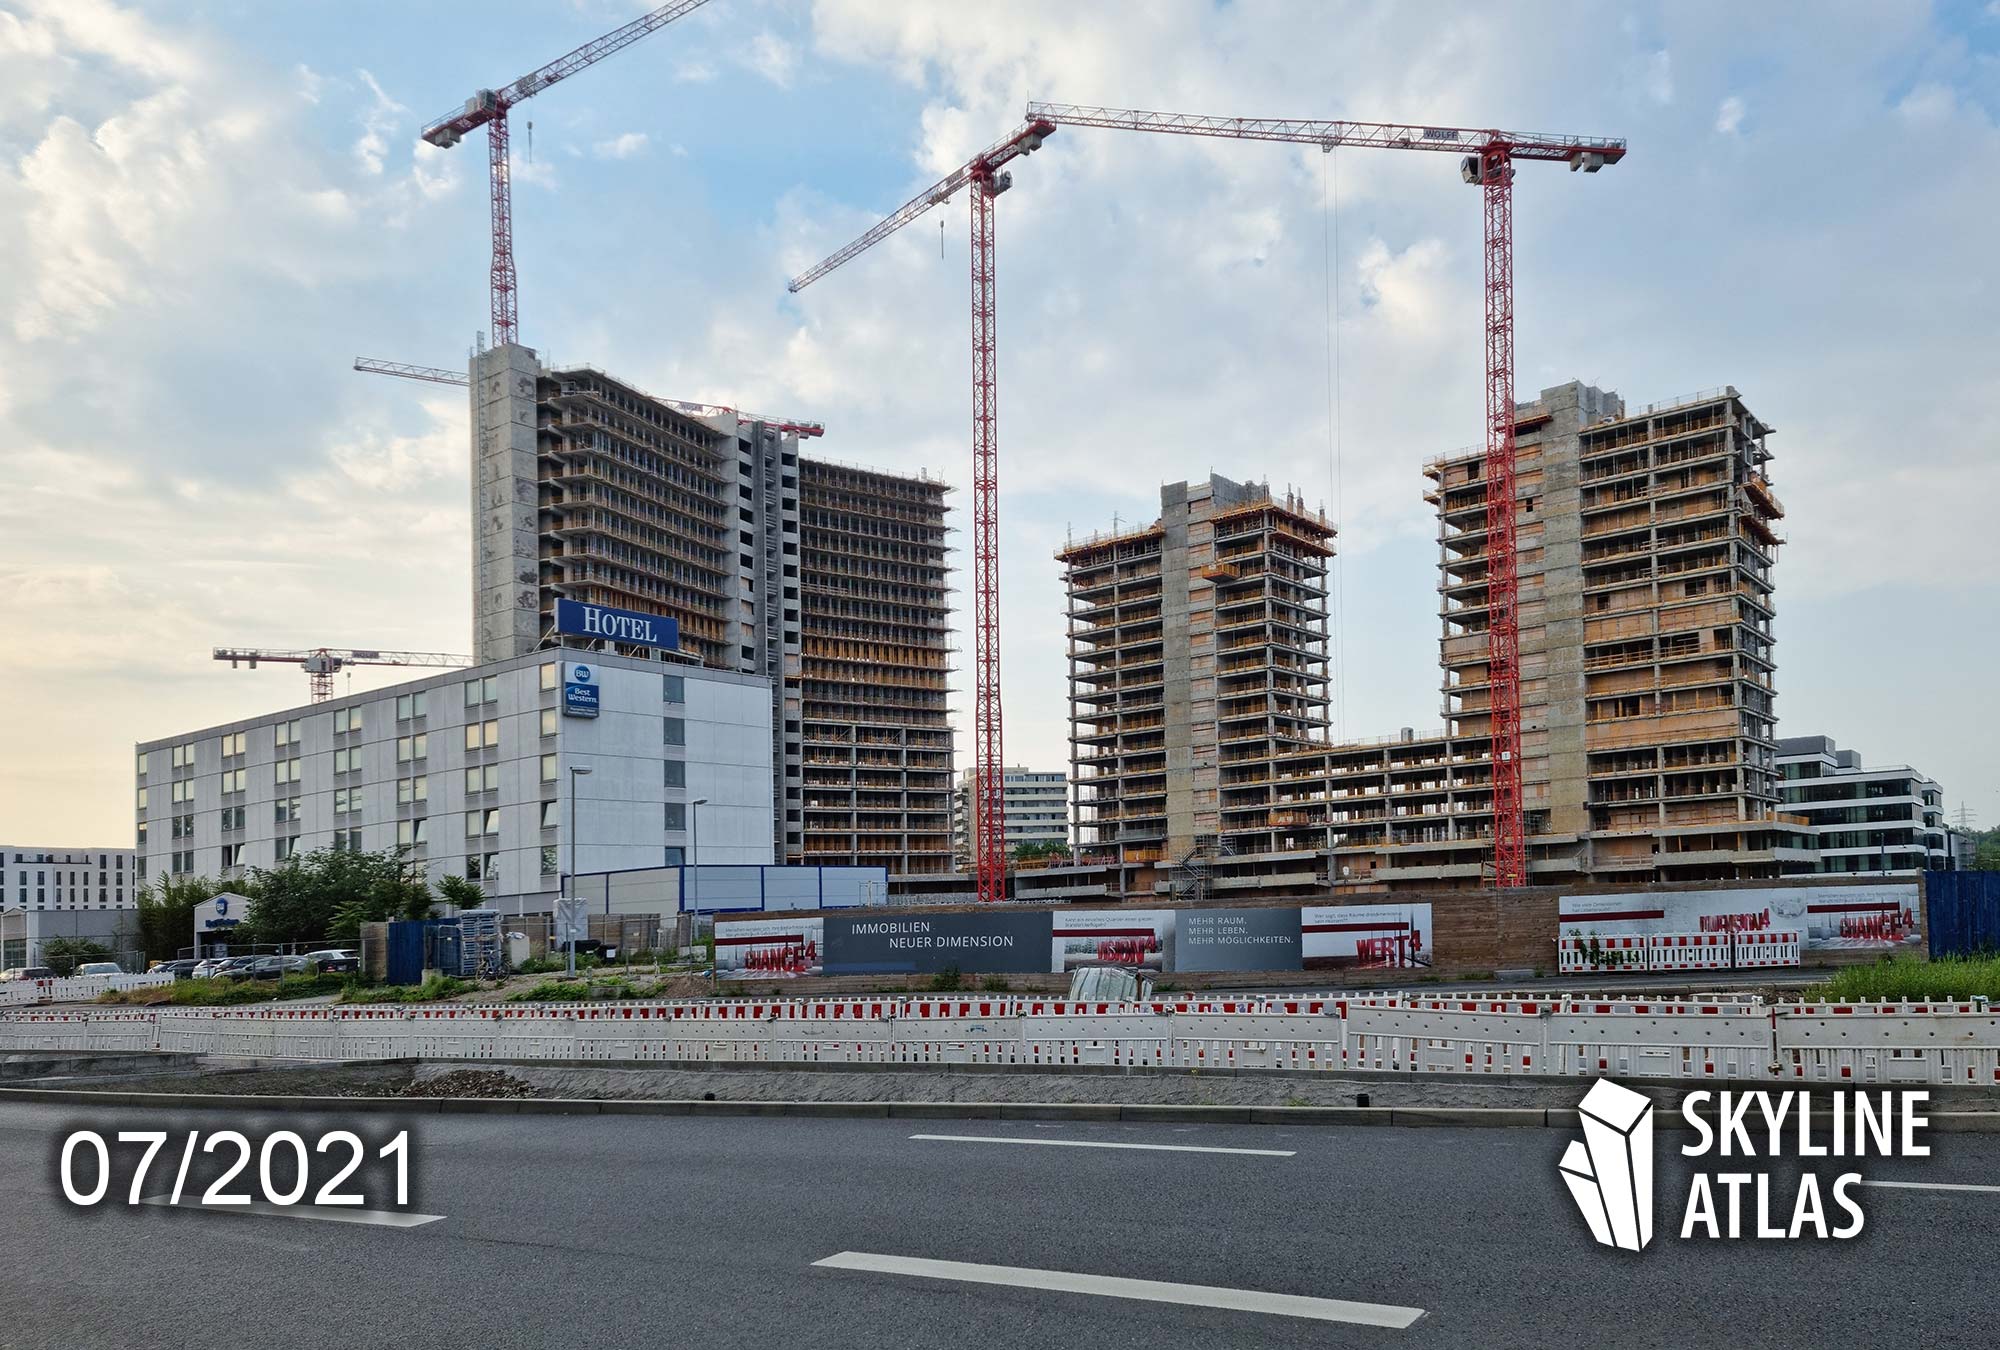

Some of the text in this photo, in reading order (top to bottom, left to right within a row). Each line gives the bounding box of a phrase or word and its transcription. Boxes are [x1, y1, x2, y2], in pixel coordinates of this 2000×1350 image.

[1426, 130, 1457, 139] WOLFF
[582, 606, 657, 642] HOTEL
[575, 669, 589, 678] BW
[574, 687, 591, 696] Best
[568, 693, 597, 703] Western
[1188, 917, 1247, 925] MEHR RAUM.
[851, 921, 930, 934] IMMOBILIEN
[1188, 926, 1248, 935] MEHR LEBEN.
[889, 935, 1014, 948] NEUER DIMENSION
[1217, 935, 1294, 944] MÖGLICHKEITEN.
